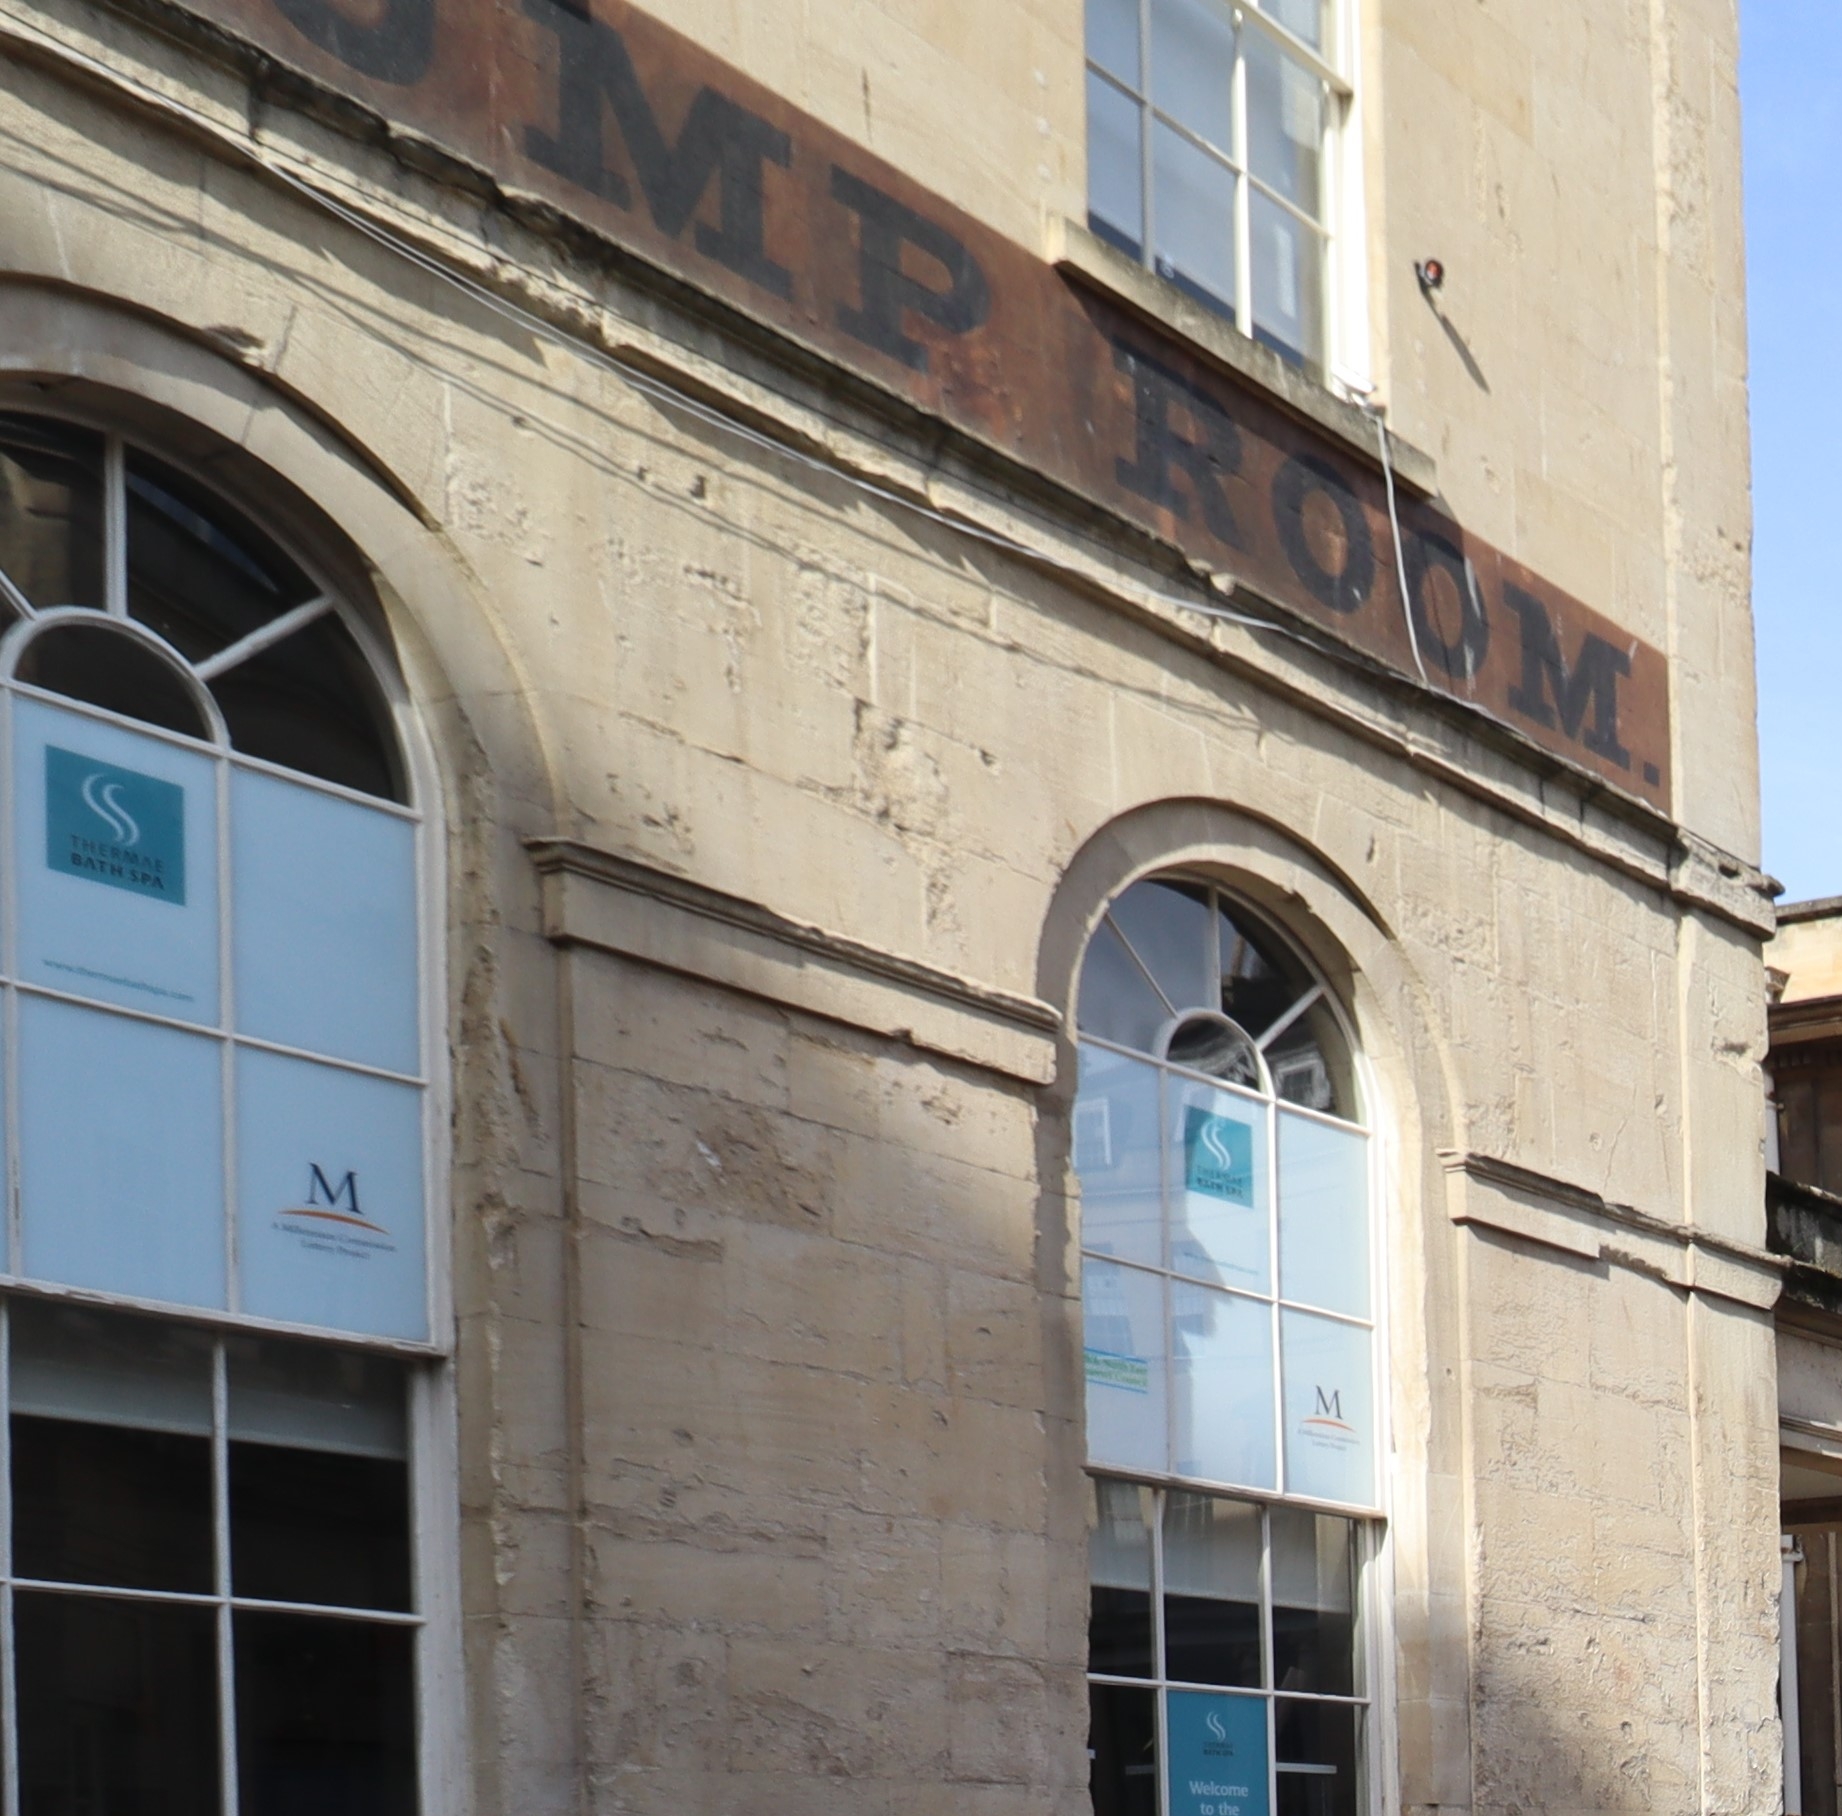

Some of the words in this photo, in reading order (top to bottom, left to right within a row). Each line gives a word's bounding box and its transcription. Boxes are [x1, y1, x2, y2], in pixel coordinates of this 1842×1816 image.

[70, 853, 124, 877] BATH
[128, 868, 165, 890] SPA
[71, 835, 164, 873] THERMAE
[306, 1162, 364, 1215] M
[1314, 1385, 1343, 1420] M
[1189, 1780, 1249, 1797] Welcome
[1200, 1802, 1214, 1815] to
[1218, 1800, 1240, 1816] the
